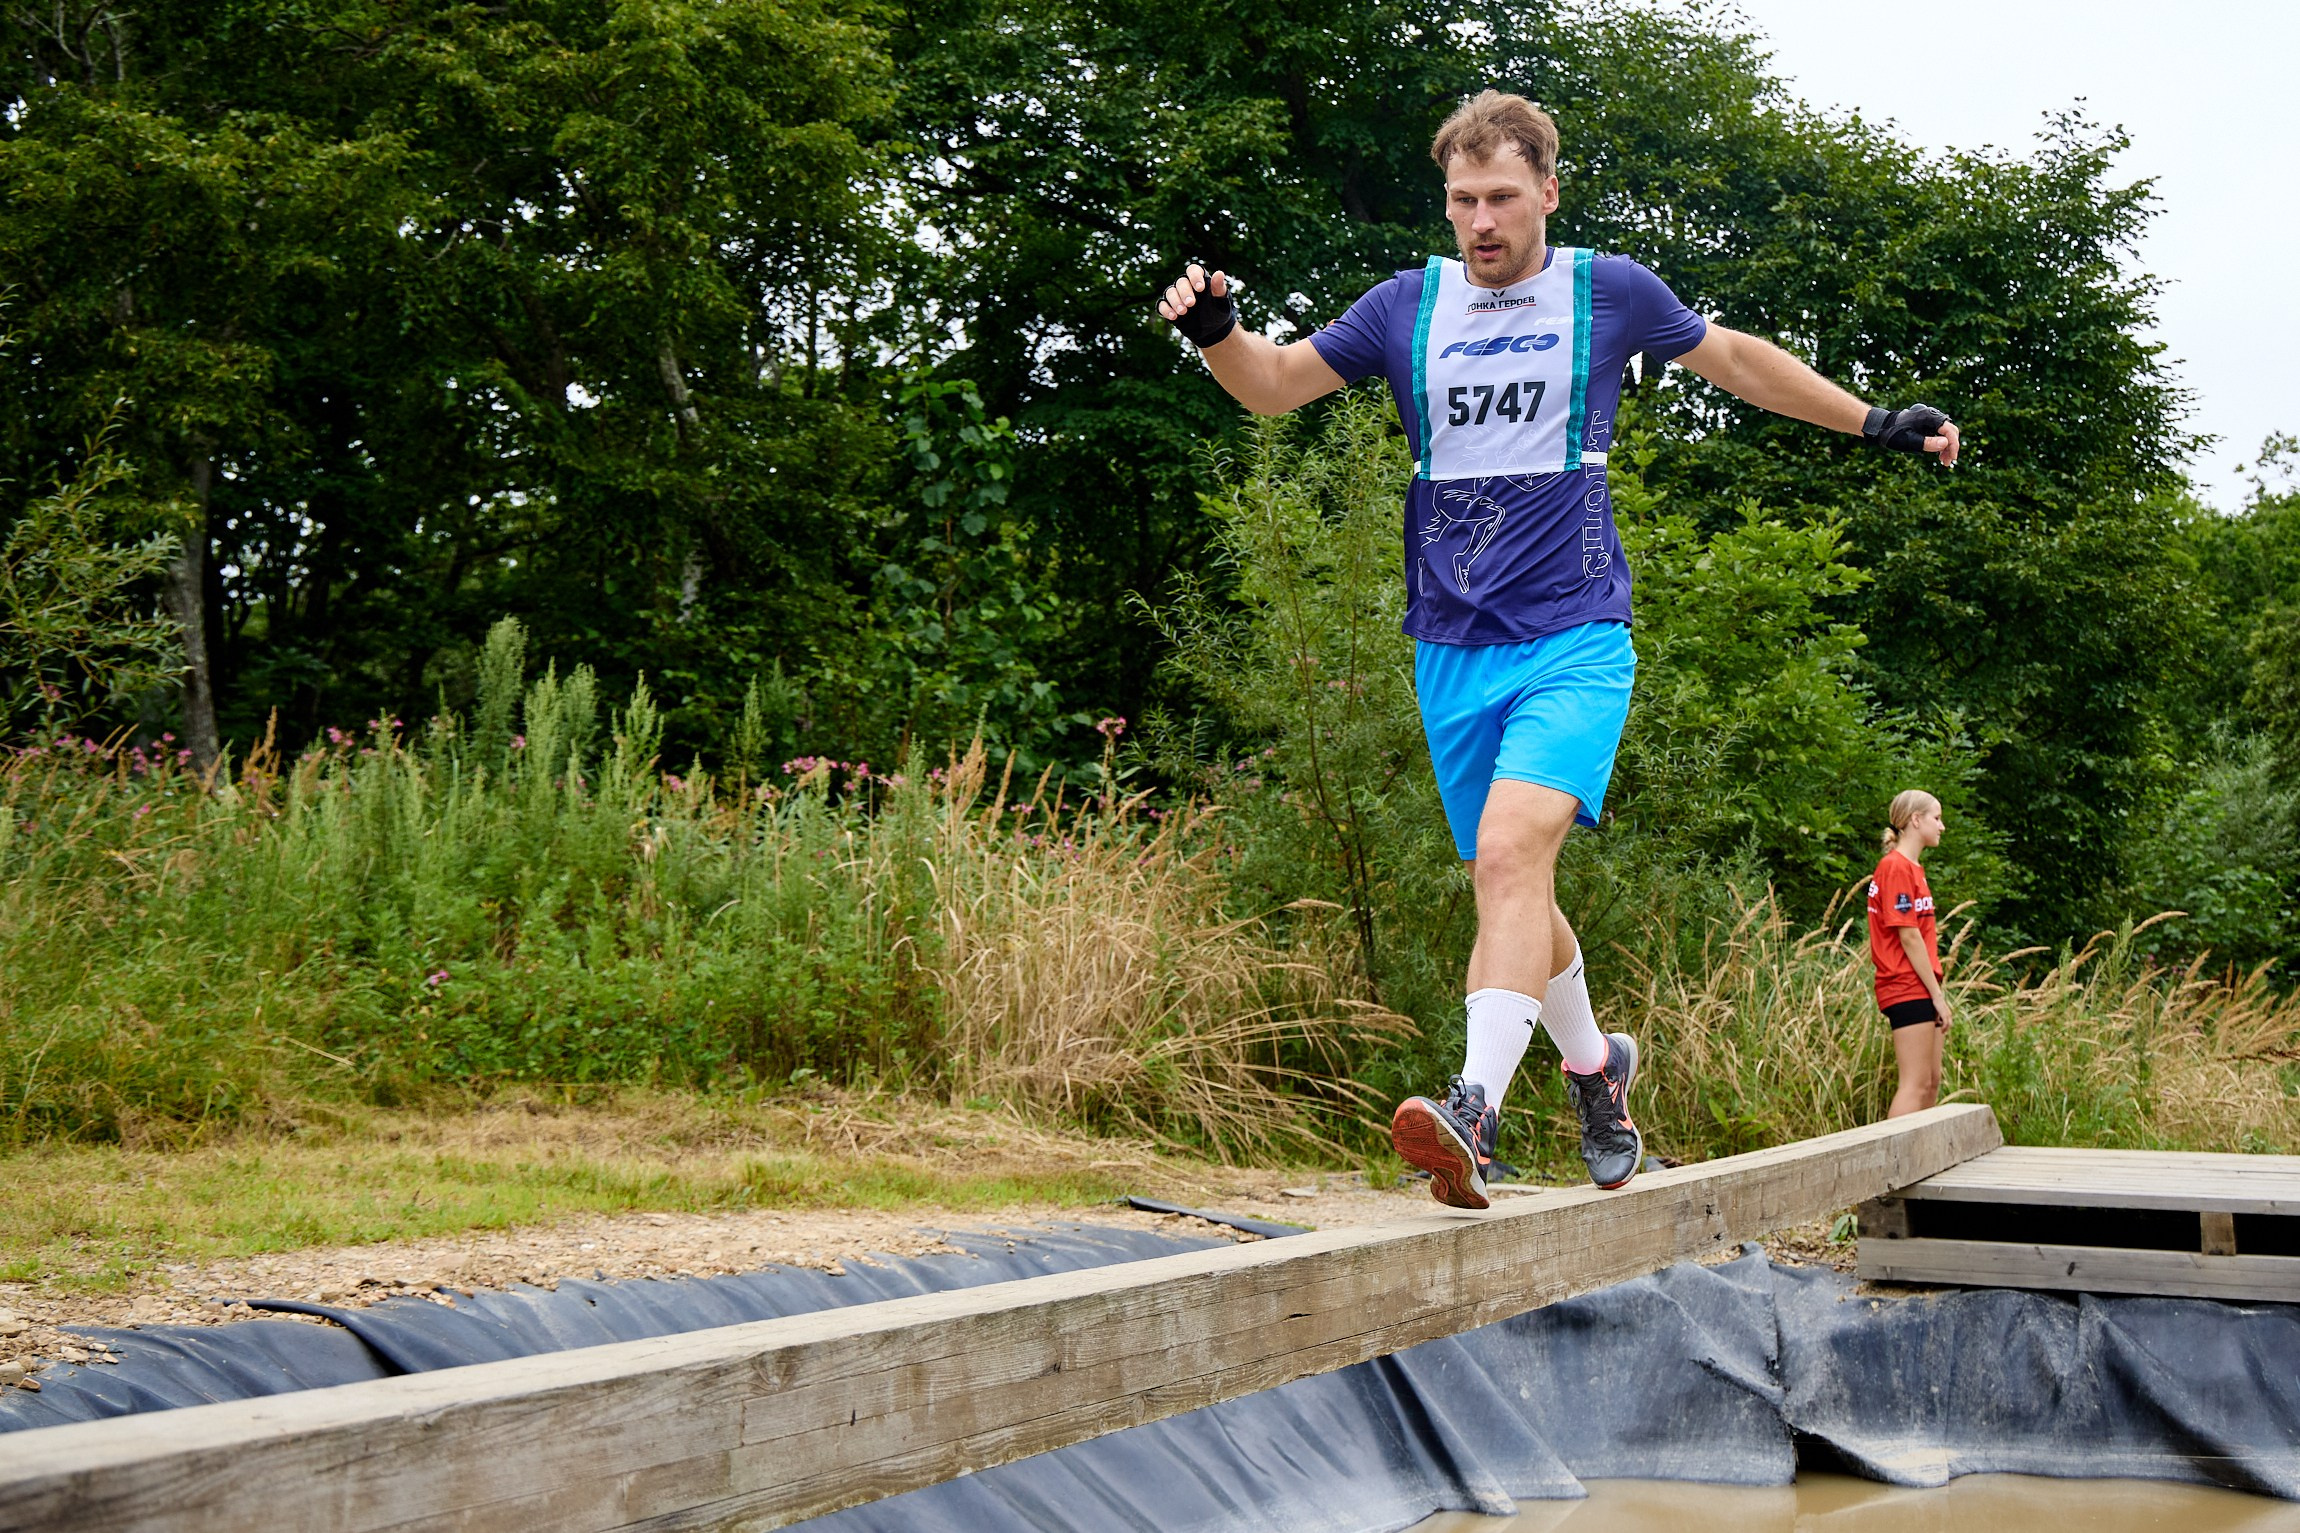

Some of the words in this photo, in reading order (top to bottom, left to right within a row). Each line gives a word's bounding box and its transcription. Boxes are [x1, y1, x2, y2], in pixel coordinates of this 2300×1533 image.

[1467, 301, 1496, 313] ГОНКА
[1498, 295, 1535, 309] ГЕРОЕВ
[1439, 333, 1560, 359] FESCO
[1448, 381, 1546, 427] 5747
